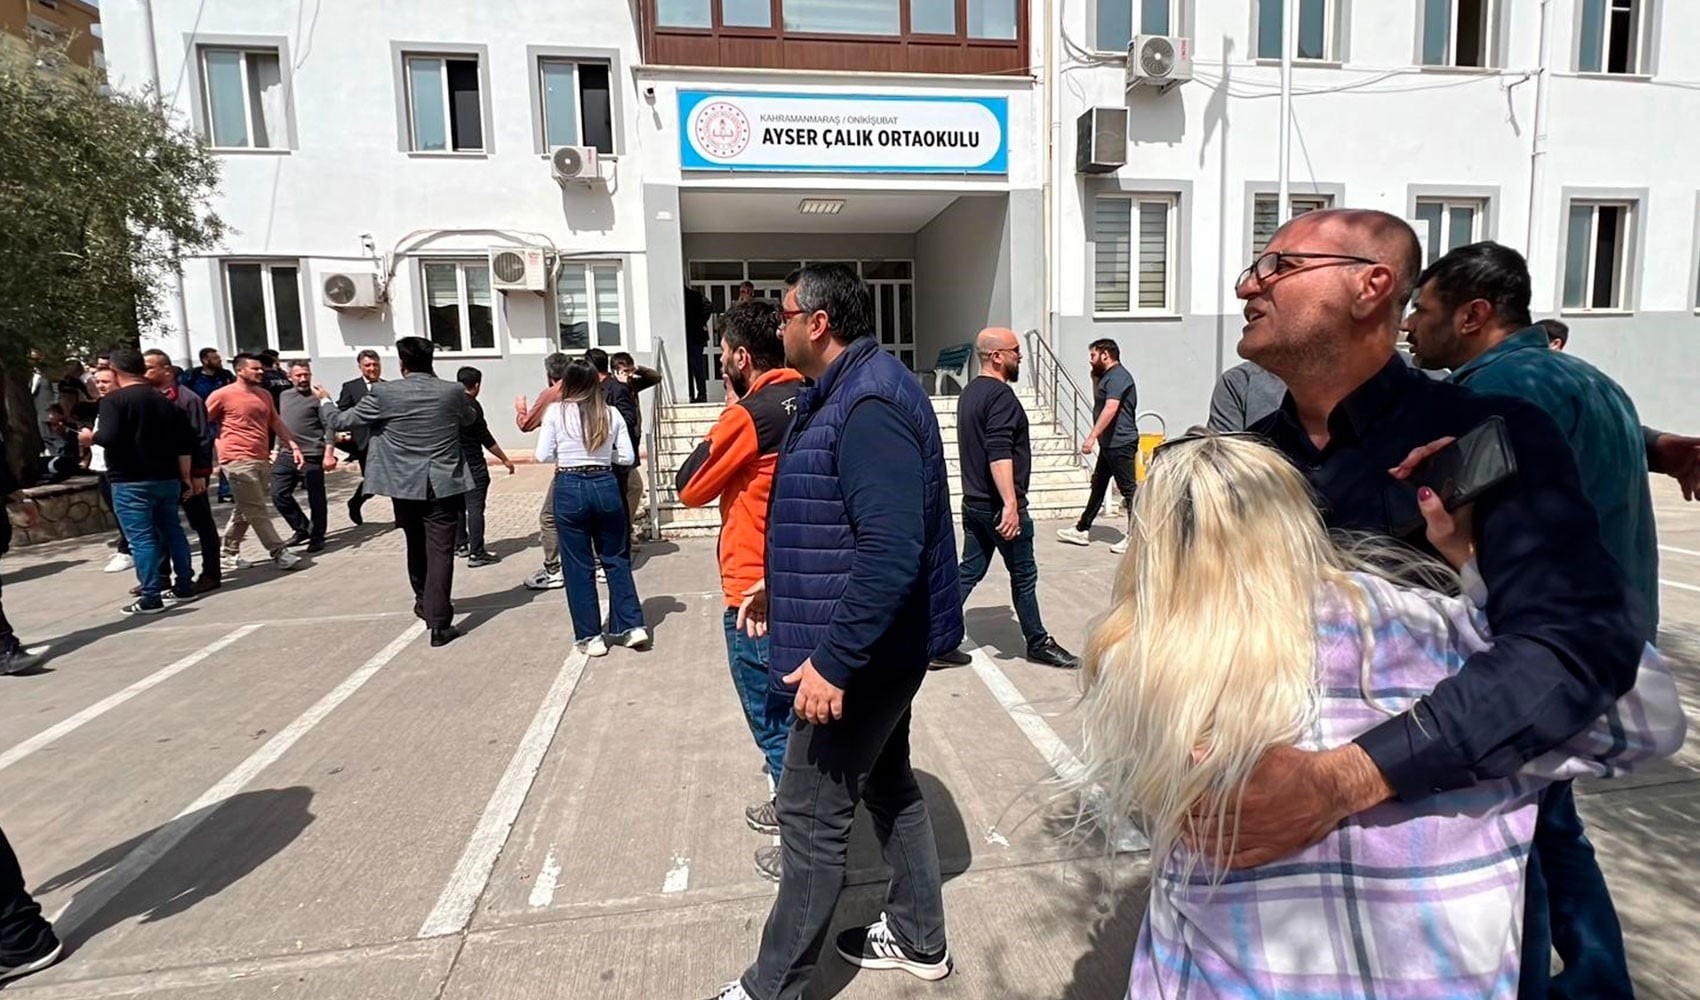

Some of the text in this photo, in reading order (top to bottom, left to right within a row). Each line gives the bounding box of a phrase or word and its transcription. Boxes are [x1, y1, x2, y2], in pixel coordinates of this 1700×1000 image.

[760, 114, 840, 125] KAHRAMANMARAŞ
[847, 115, 898, 126] ONİKİŞUBAT
[762, 128, 818, 145] AYSER
[823, 129, 873, 149] ÇALIK
[878, 130, 979, 147] ORTAOKULU
